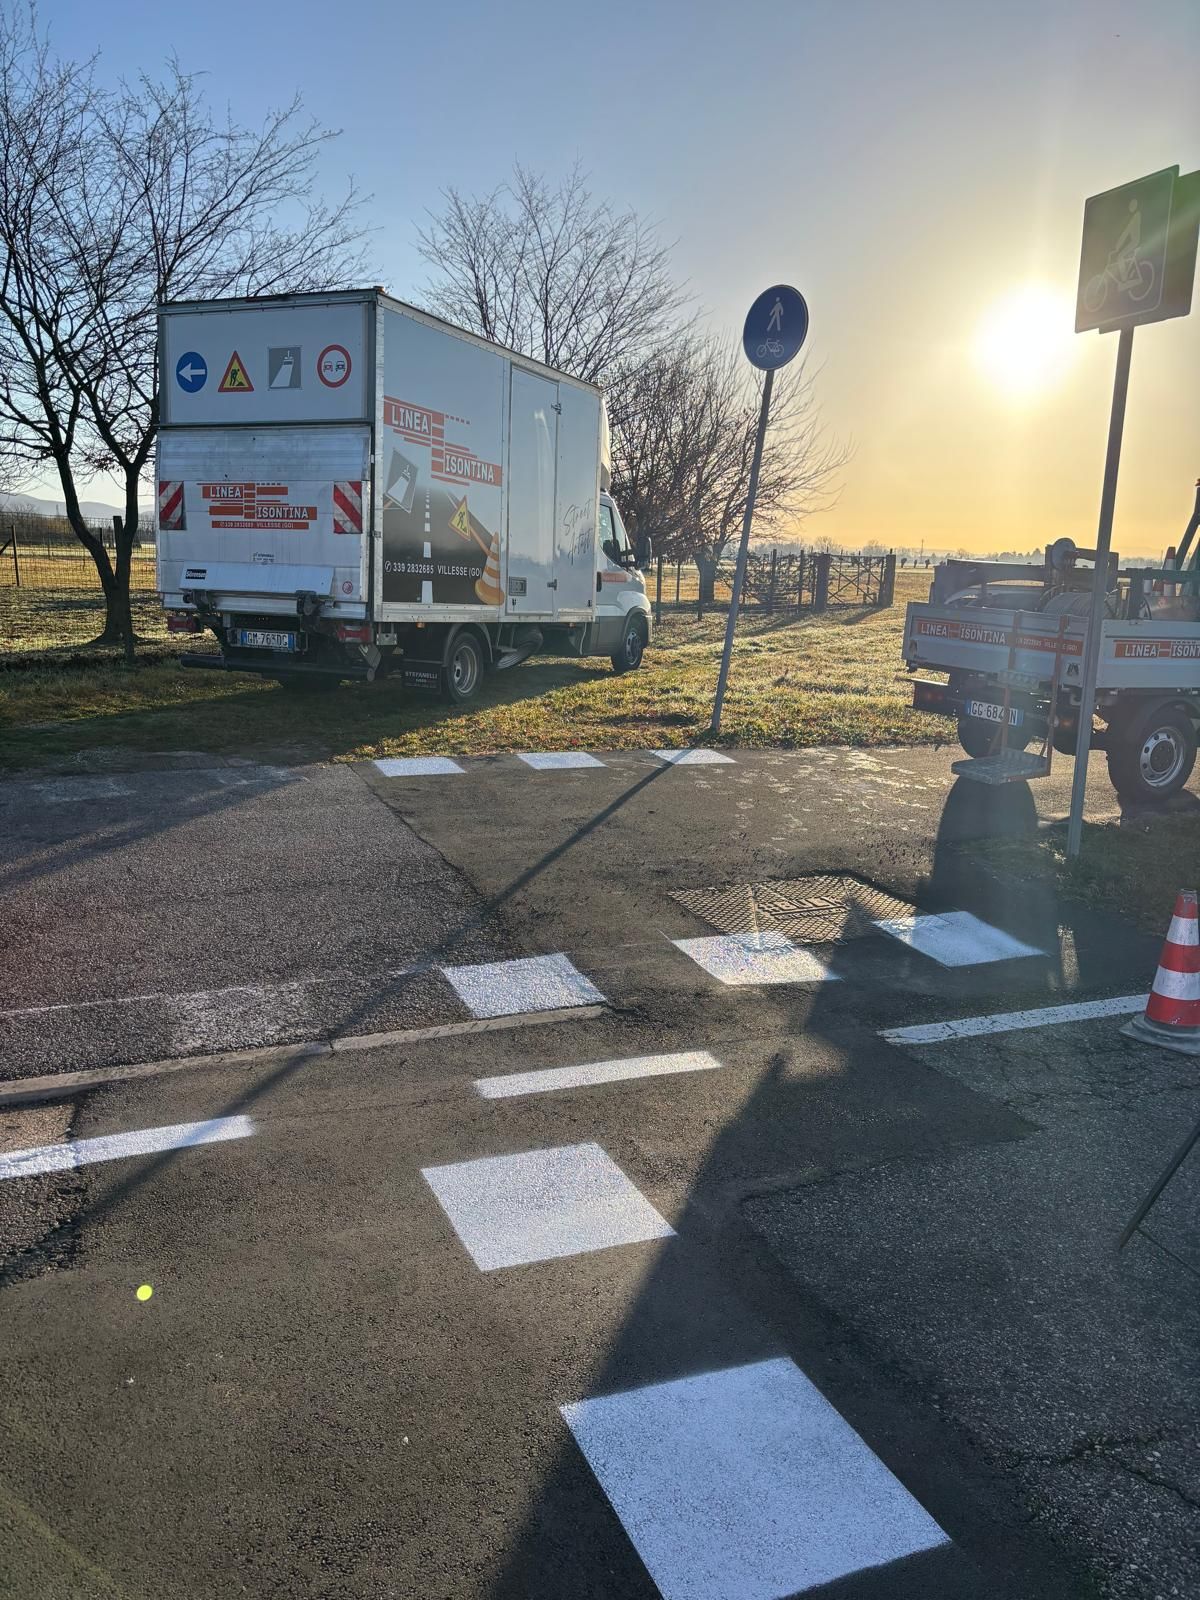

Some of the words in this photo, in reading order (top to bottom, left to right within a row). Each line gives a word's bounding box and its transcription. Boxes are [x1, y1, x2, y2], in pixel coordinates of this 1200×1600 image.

[391, 405, 429, 433] LINEA
[445, 454, 494, 482] ISONTINA
[210, 486, 242, 498] LINEA
[257, 507, 309, 519] ISONTINA
[393, 562, 406, 572] 339
[437, 565, 468, 576] VILLESSE
[921, 623, 948, 636] LINEA
[960, 627, 1006, 645] ISONTINA
[1124, 644, 1157, 657] LINEA
